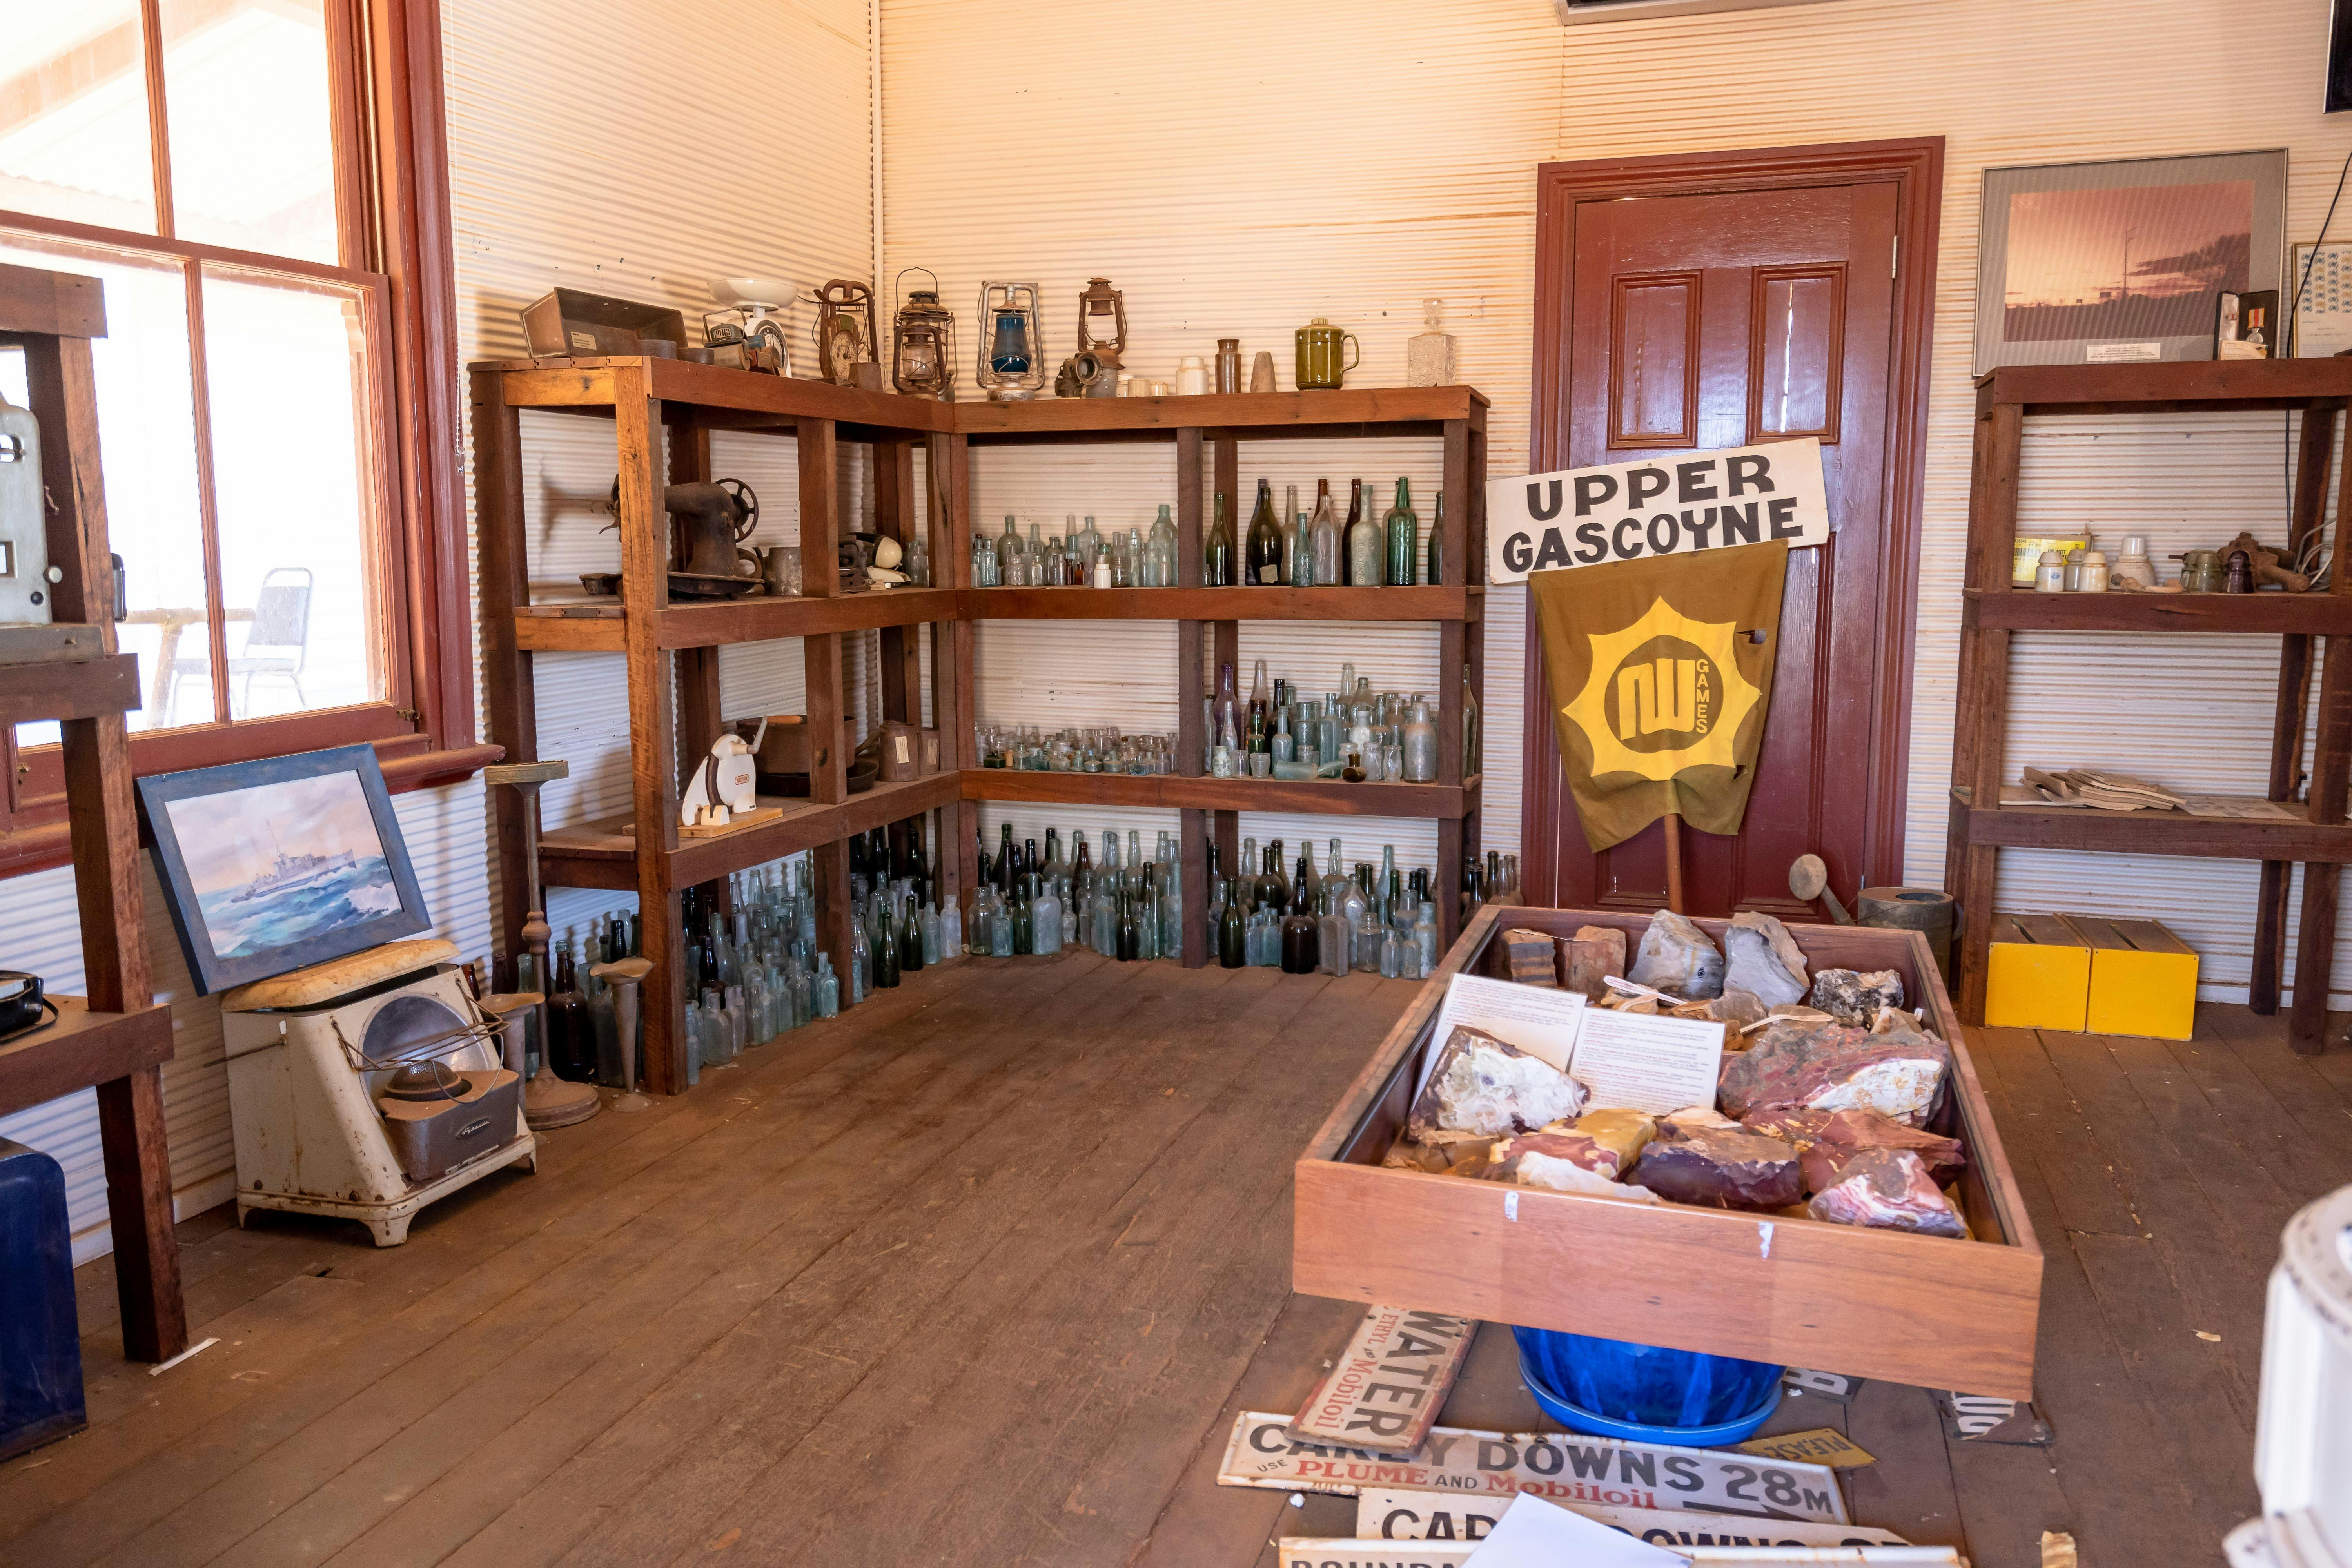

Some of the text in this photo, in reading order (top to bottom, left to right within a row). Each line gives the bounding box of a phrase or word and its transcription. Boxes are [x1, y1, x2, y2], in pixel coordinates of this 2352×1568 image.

[1526, 454, 1775, 521] UPPER
[1503, 496, 1803, 573] GASCOYNE
[1696, 659, 1710, 733] GAMES
[1367, 1314, 1399, 1344] ETHYL
[1314, 1358, 1378, 1429] Mobiloil
[1344, 1311, 1462, 1437] WATER
[1257, 1459, 1658, 1510] USE PLUME AND Mobiloil
[1477, 1440, 1704, 1492] DOWNS
